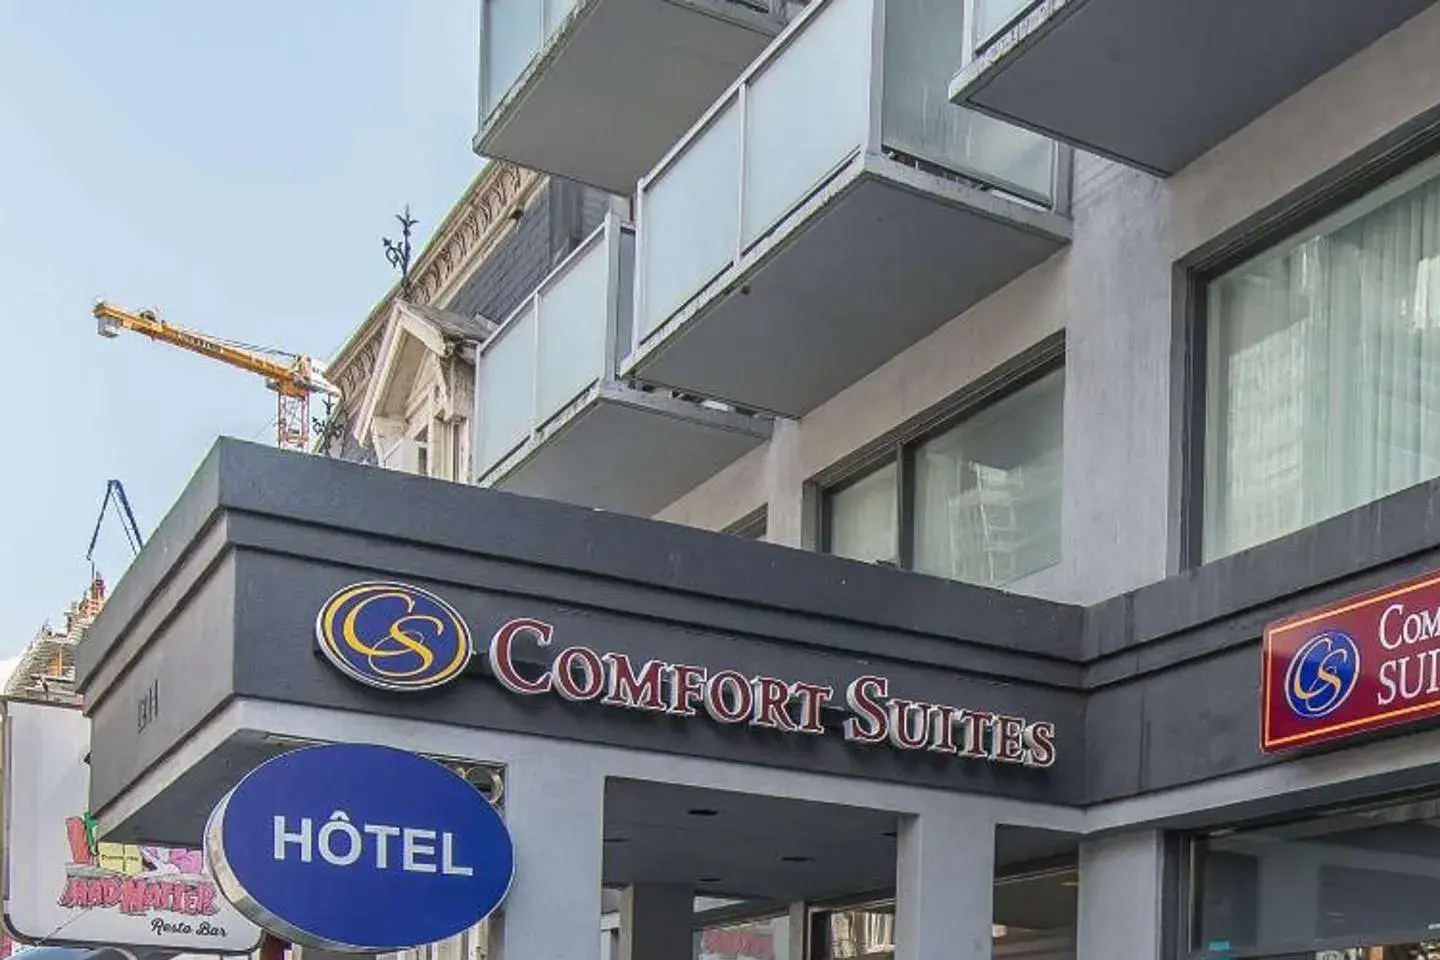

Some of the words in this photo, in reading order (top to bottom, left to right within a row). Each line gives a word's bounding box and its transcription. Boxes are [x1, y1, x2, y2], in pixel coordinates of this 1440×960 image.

[490, 617, 832, 736] COMFORT
[843, 676, 1056, 769] SUITES
[272, 810, 474, 877] HÔTEL
[151, 917, 193, 935] Resto
[195, 921, 229, 938] Bar
